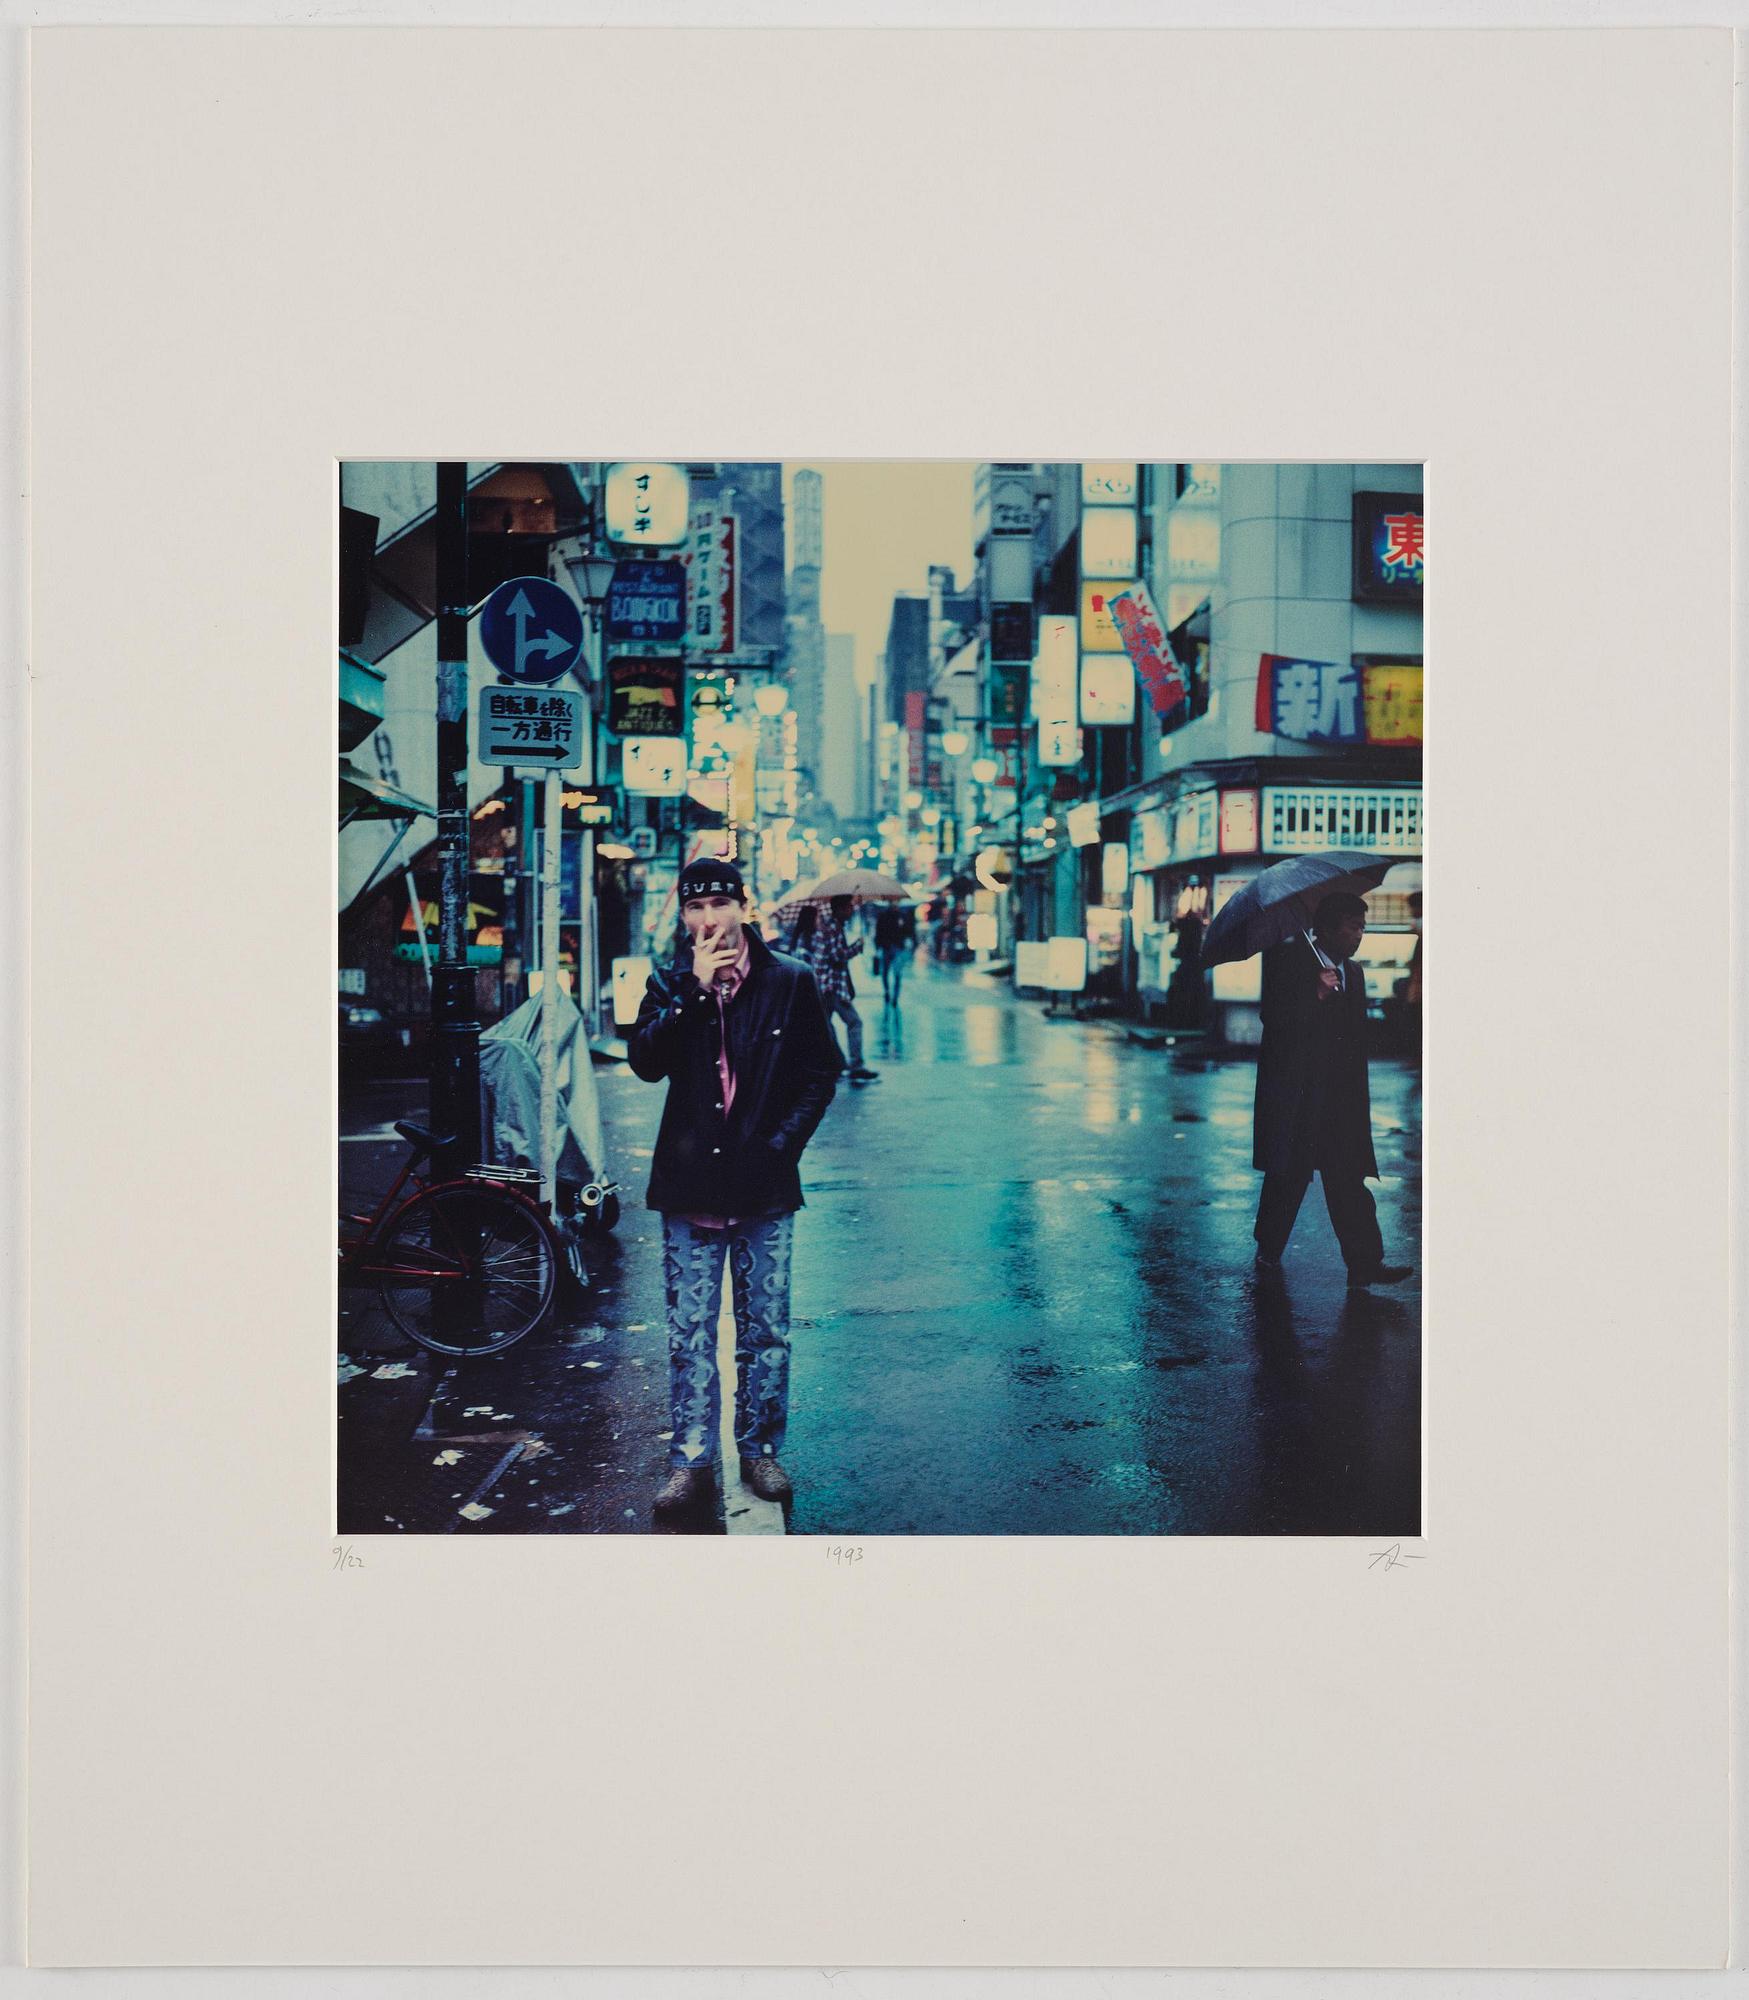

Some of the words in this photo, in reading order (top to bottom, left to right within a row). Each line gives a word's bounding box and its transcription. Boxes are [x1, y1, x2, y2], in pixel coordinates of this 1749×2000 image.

[1088, 478, 1131, 494] さくら
[635, 474, 651, 535] すし半
[1382, 512, 1423, 567] 東
[490, 694, 573, 717] 自転車を除く
[1277, 663, 1357, 738] 新
[490, 721, 573, 742] 一方通行
[332, 1545, 365, 1571] 9/22
[826, 1546, 864, 1566] 1993
